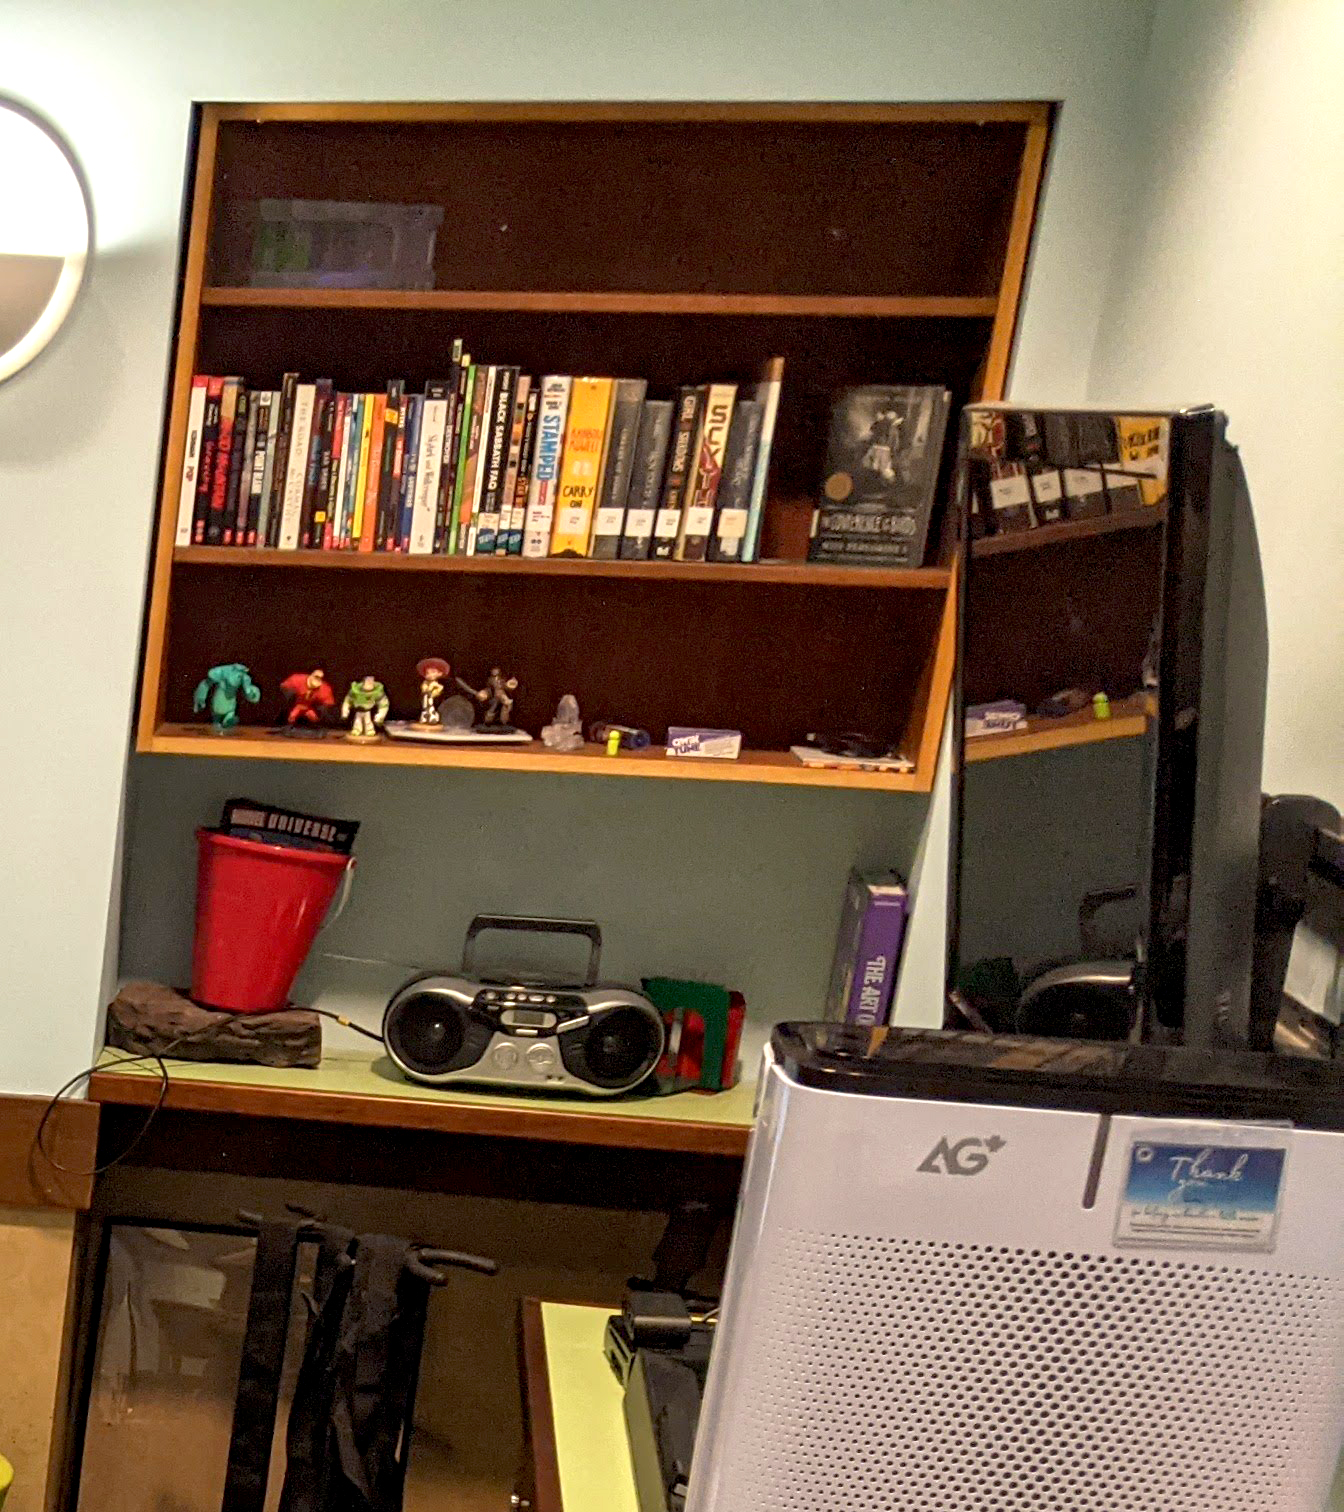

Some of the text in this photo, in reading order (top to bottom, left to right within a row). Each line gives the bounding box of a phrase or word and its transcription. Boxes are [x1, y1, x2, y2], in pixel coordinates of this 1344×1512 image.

[496, 392, 509, 423] BLACK
[295, 426, 306, 456] ROAD
[490, 425, 506, 468] SABBATH
[536, 415, 561, 481] STAMPED
[487, 471, 501, 491] FAQ
[562, 485, 594, 498] CARRY
[267, 813, 338, 842] UNIVERSE
[858, 986, 882, 1013] ART
[1168, 1147, 1250, 1182] Thank
